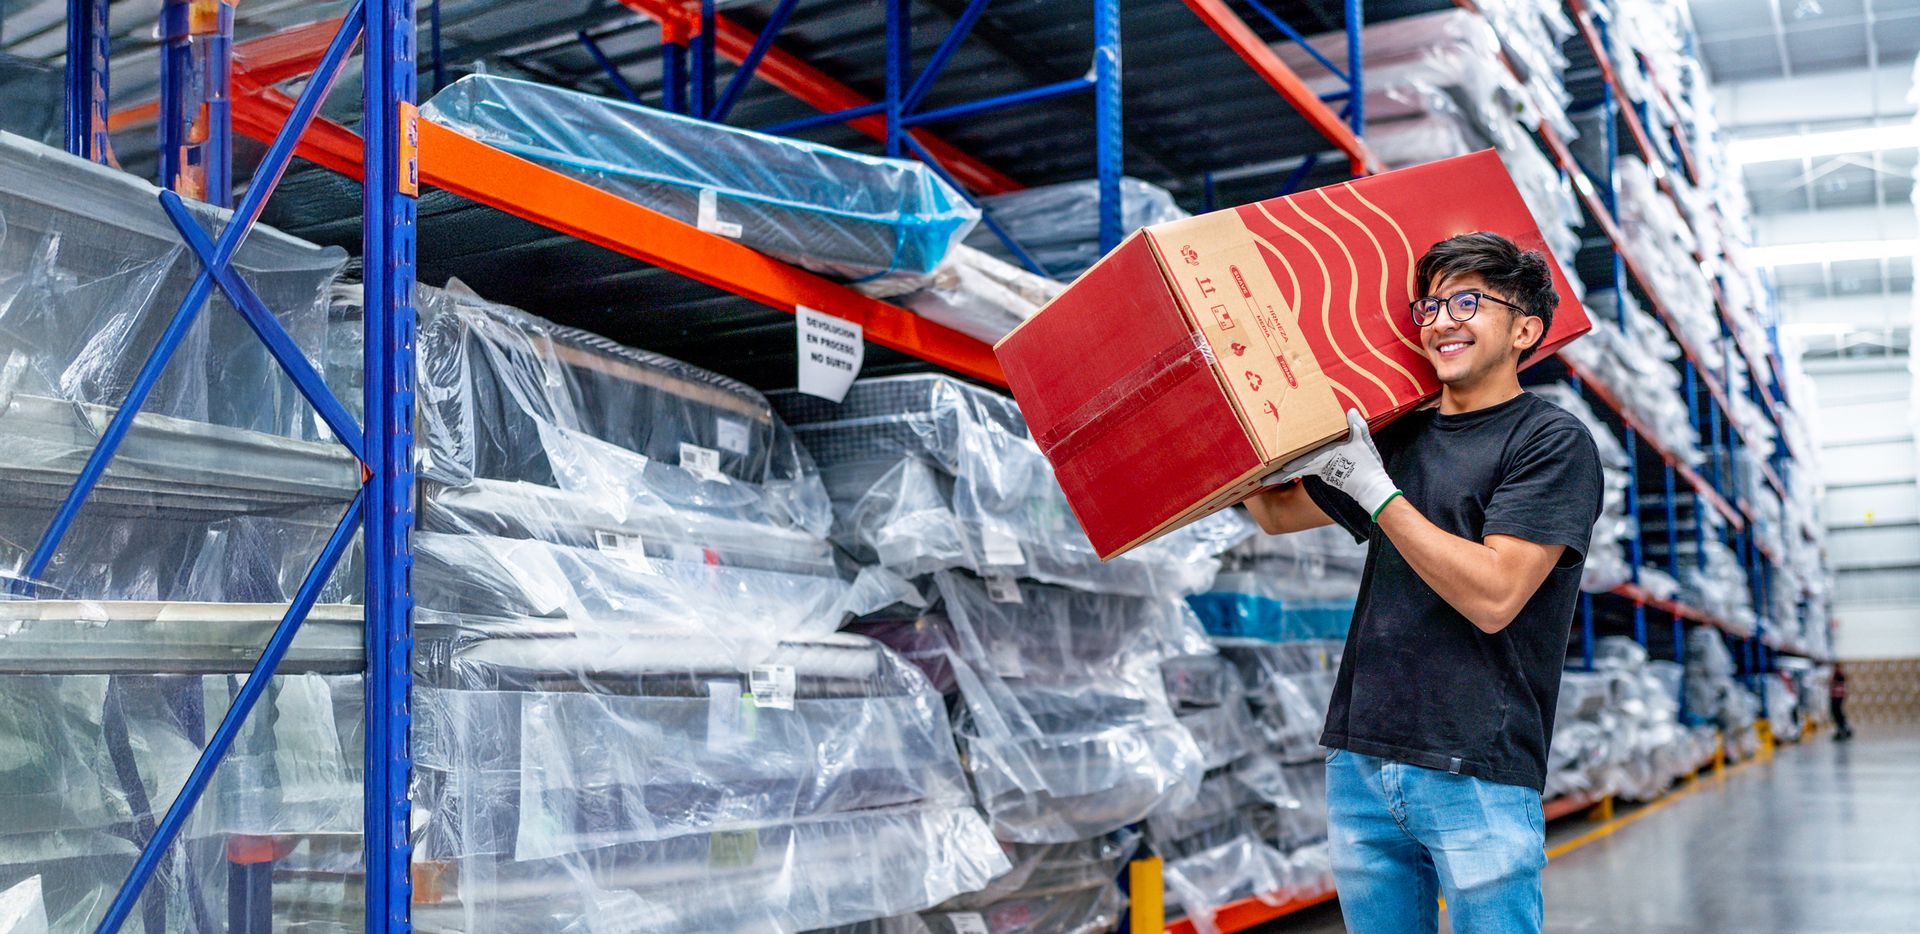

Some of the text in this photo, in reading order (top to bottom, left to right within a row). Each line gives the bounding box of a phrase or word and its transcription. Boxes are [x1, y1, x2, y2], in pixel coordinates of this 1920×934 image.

[1232, 269, 1249, 294] SUAVE
[1257, 315, 1270, 338] MEDIA
[1267, 304, 1289, 343] FIRMEZA
[806, 333, 818, 344] EN
[811, 352, 824, 363] NO
[1279, 360, 1295, 383] FIRME
